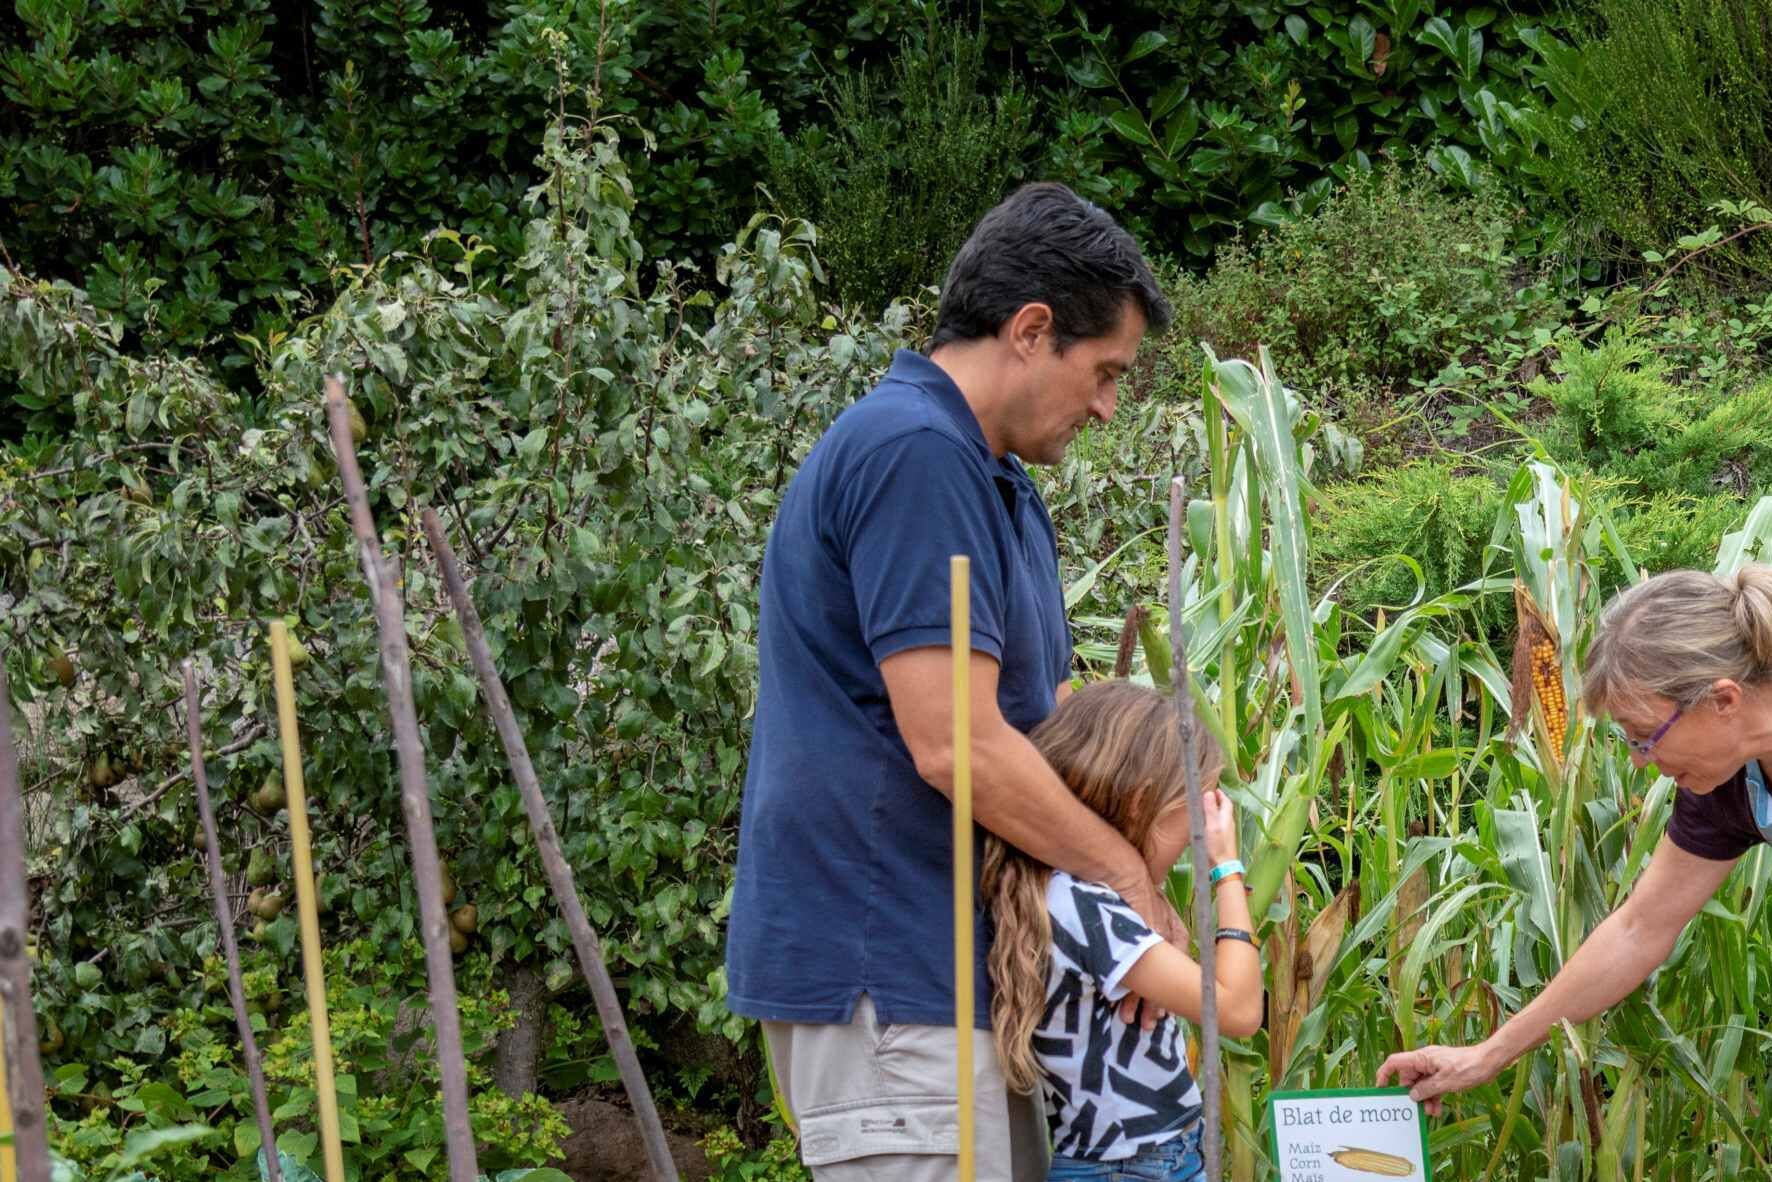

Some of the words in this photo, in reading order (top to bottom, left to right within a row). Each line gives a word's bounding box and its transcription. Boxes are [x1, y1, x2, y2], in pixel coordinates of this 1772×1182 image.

[1282, 1107, 1323, 1126] Blat
[1329, 1105, 1353, 1123] de
[1360, 1107, 1413, 1122] moro
[1290, 1158, 1321, 1169] Corn
